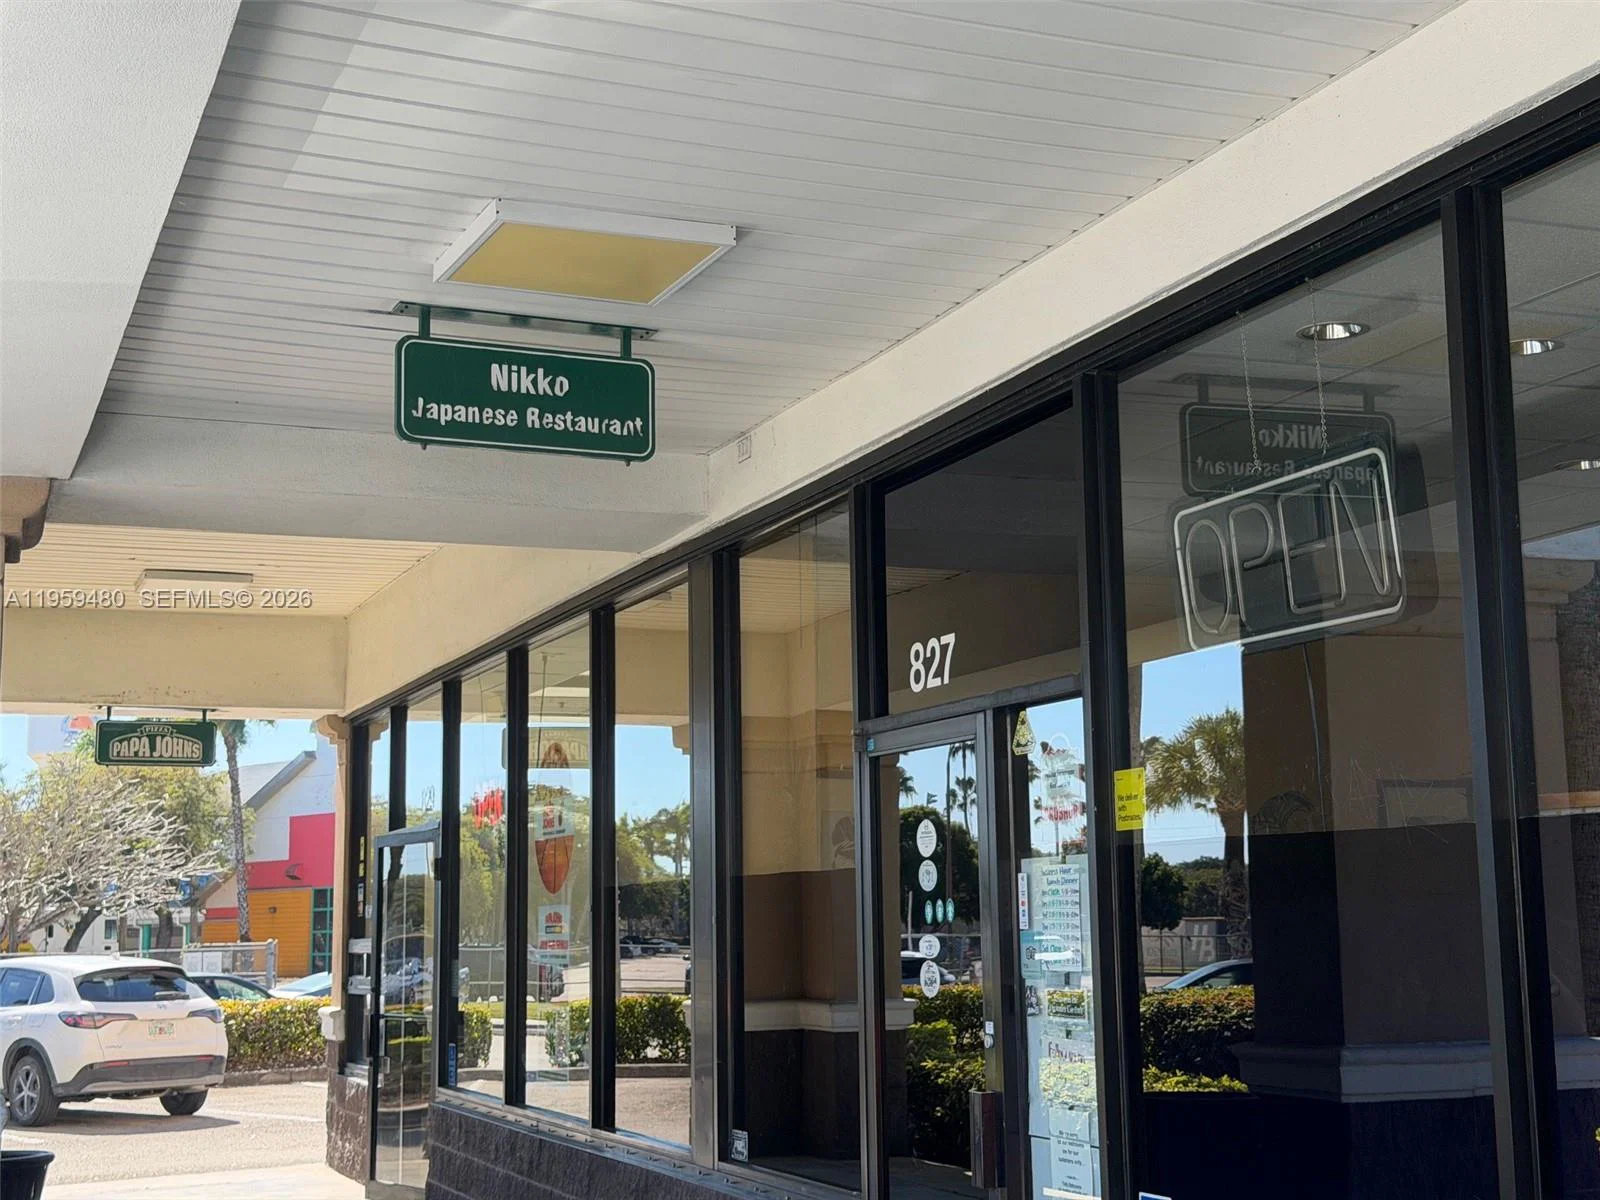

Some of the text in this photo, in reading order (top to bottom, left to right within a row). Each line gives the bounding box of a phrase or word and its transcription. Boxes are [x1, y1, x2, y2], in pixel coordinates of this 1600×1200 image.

[490, 363, 570, 397] Nikko
[411, 397, 643, 437] Japanese Restaurant
[1186, 470, 1390, 634] OPEN
[909, 632, 956, 693] 827
[113, 736, 200, 758] PAPA JOHNS
